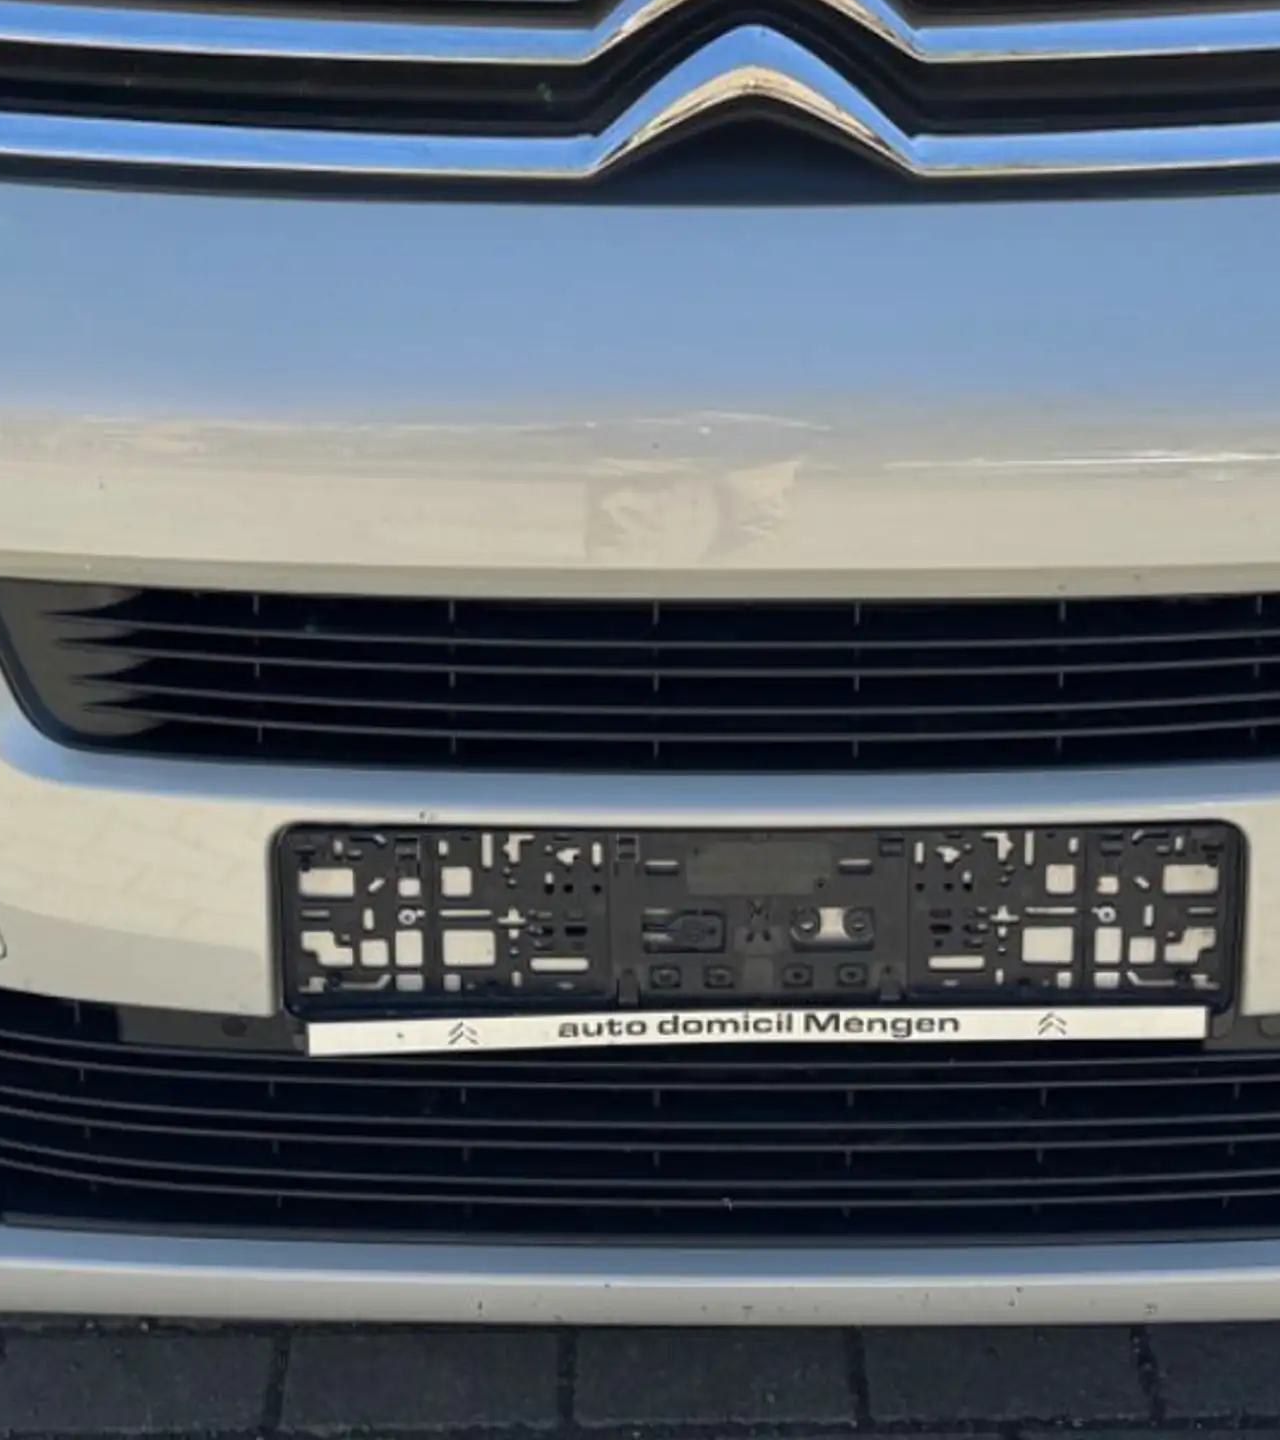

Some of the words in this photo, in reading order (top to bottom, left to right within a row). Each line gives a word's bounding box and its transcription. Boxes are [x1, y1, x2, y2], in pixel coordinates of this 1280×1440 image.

[557, 1017, 647, 1038] auto
[657, 1012, 793, 1036] domicil
[803, 1013, 960, 1038] Mengen
